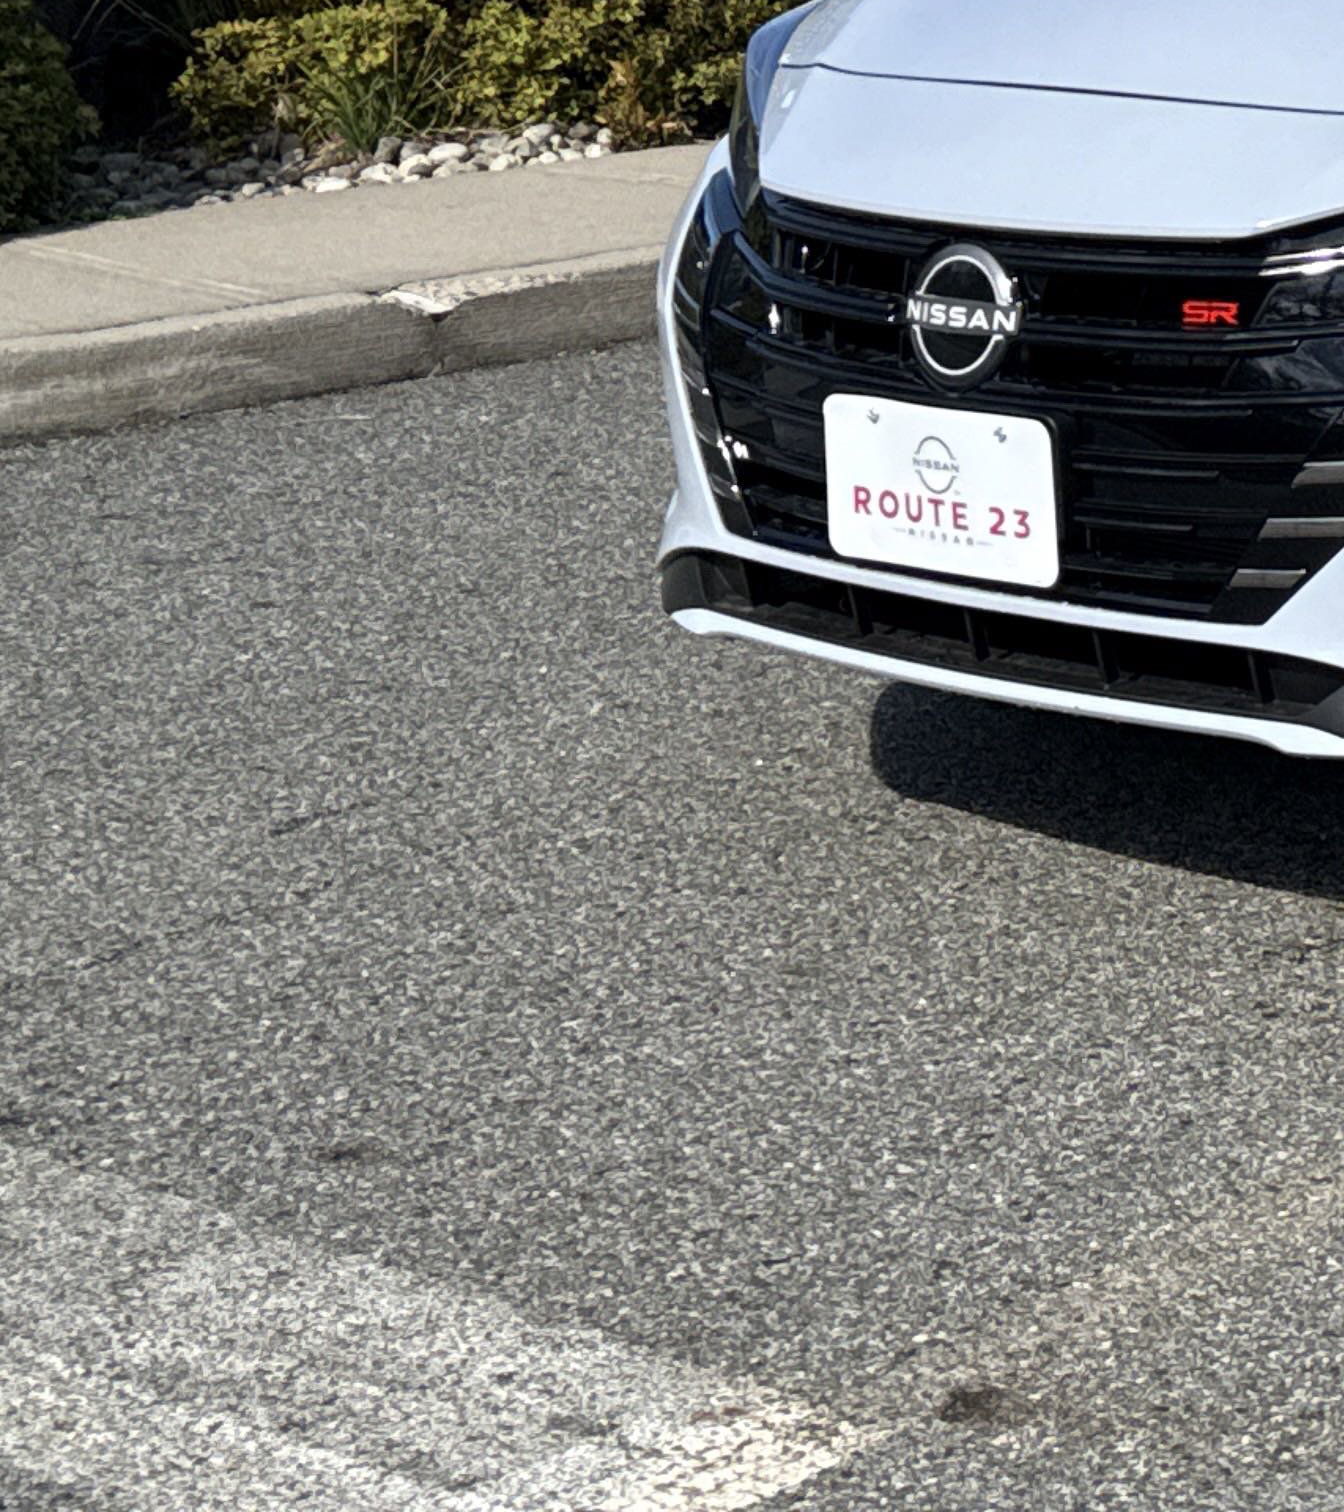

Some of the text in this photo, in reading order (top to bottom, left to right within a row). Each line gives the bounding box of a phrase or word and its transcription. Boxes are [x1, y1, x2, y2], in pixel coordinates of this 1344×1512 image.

[906, 297, 1017, 333] NISSAN
[1182, 300, 1239, 325] SR
[912, 456, 960, 474] NISSAN
[853, 485, 1031, 539] ROUTE 23
